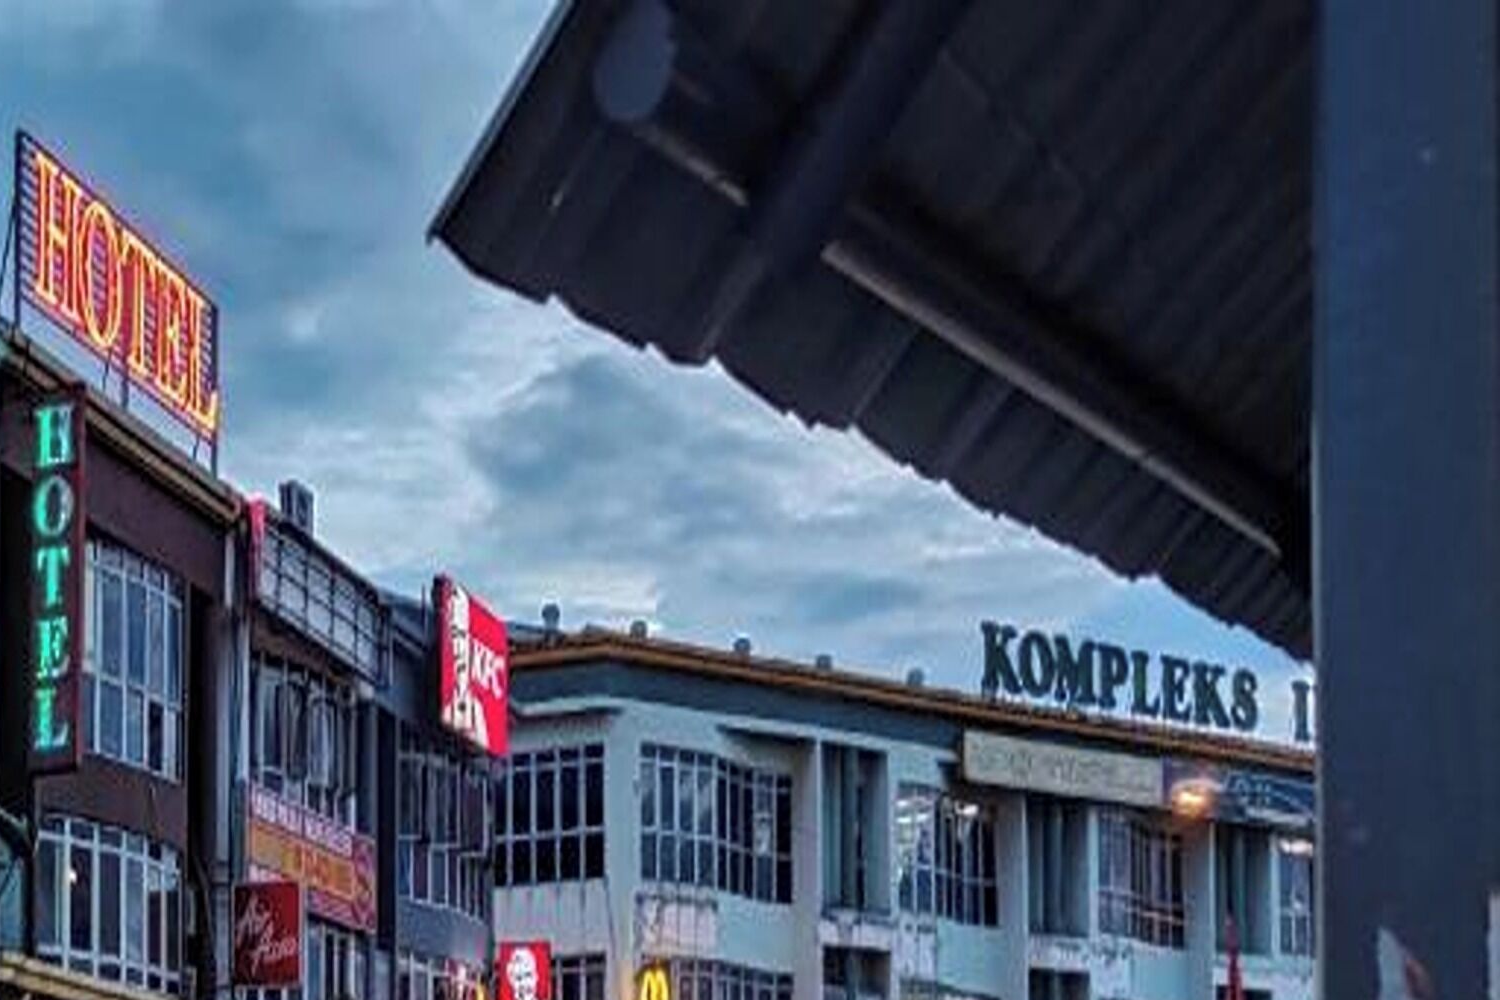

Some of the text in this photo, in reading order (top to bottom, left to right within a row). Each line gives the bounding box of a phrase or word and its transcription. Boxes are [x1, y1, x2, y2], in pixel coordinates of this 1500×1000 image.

[34, 150, 218, 431] HOTEL
[32, 405, 75, 750] HOTEL
[471, 637, 505, 700] KFC
[980, 620, 1259, 732] KOMPLEKS
